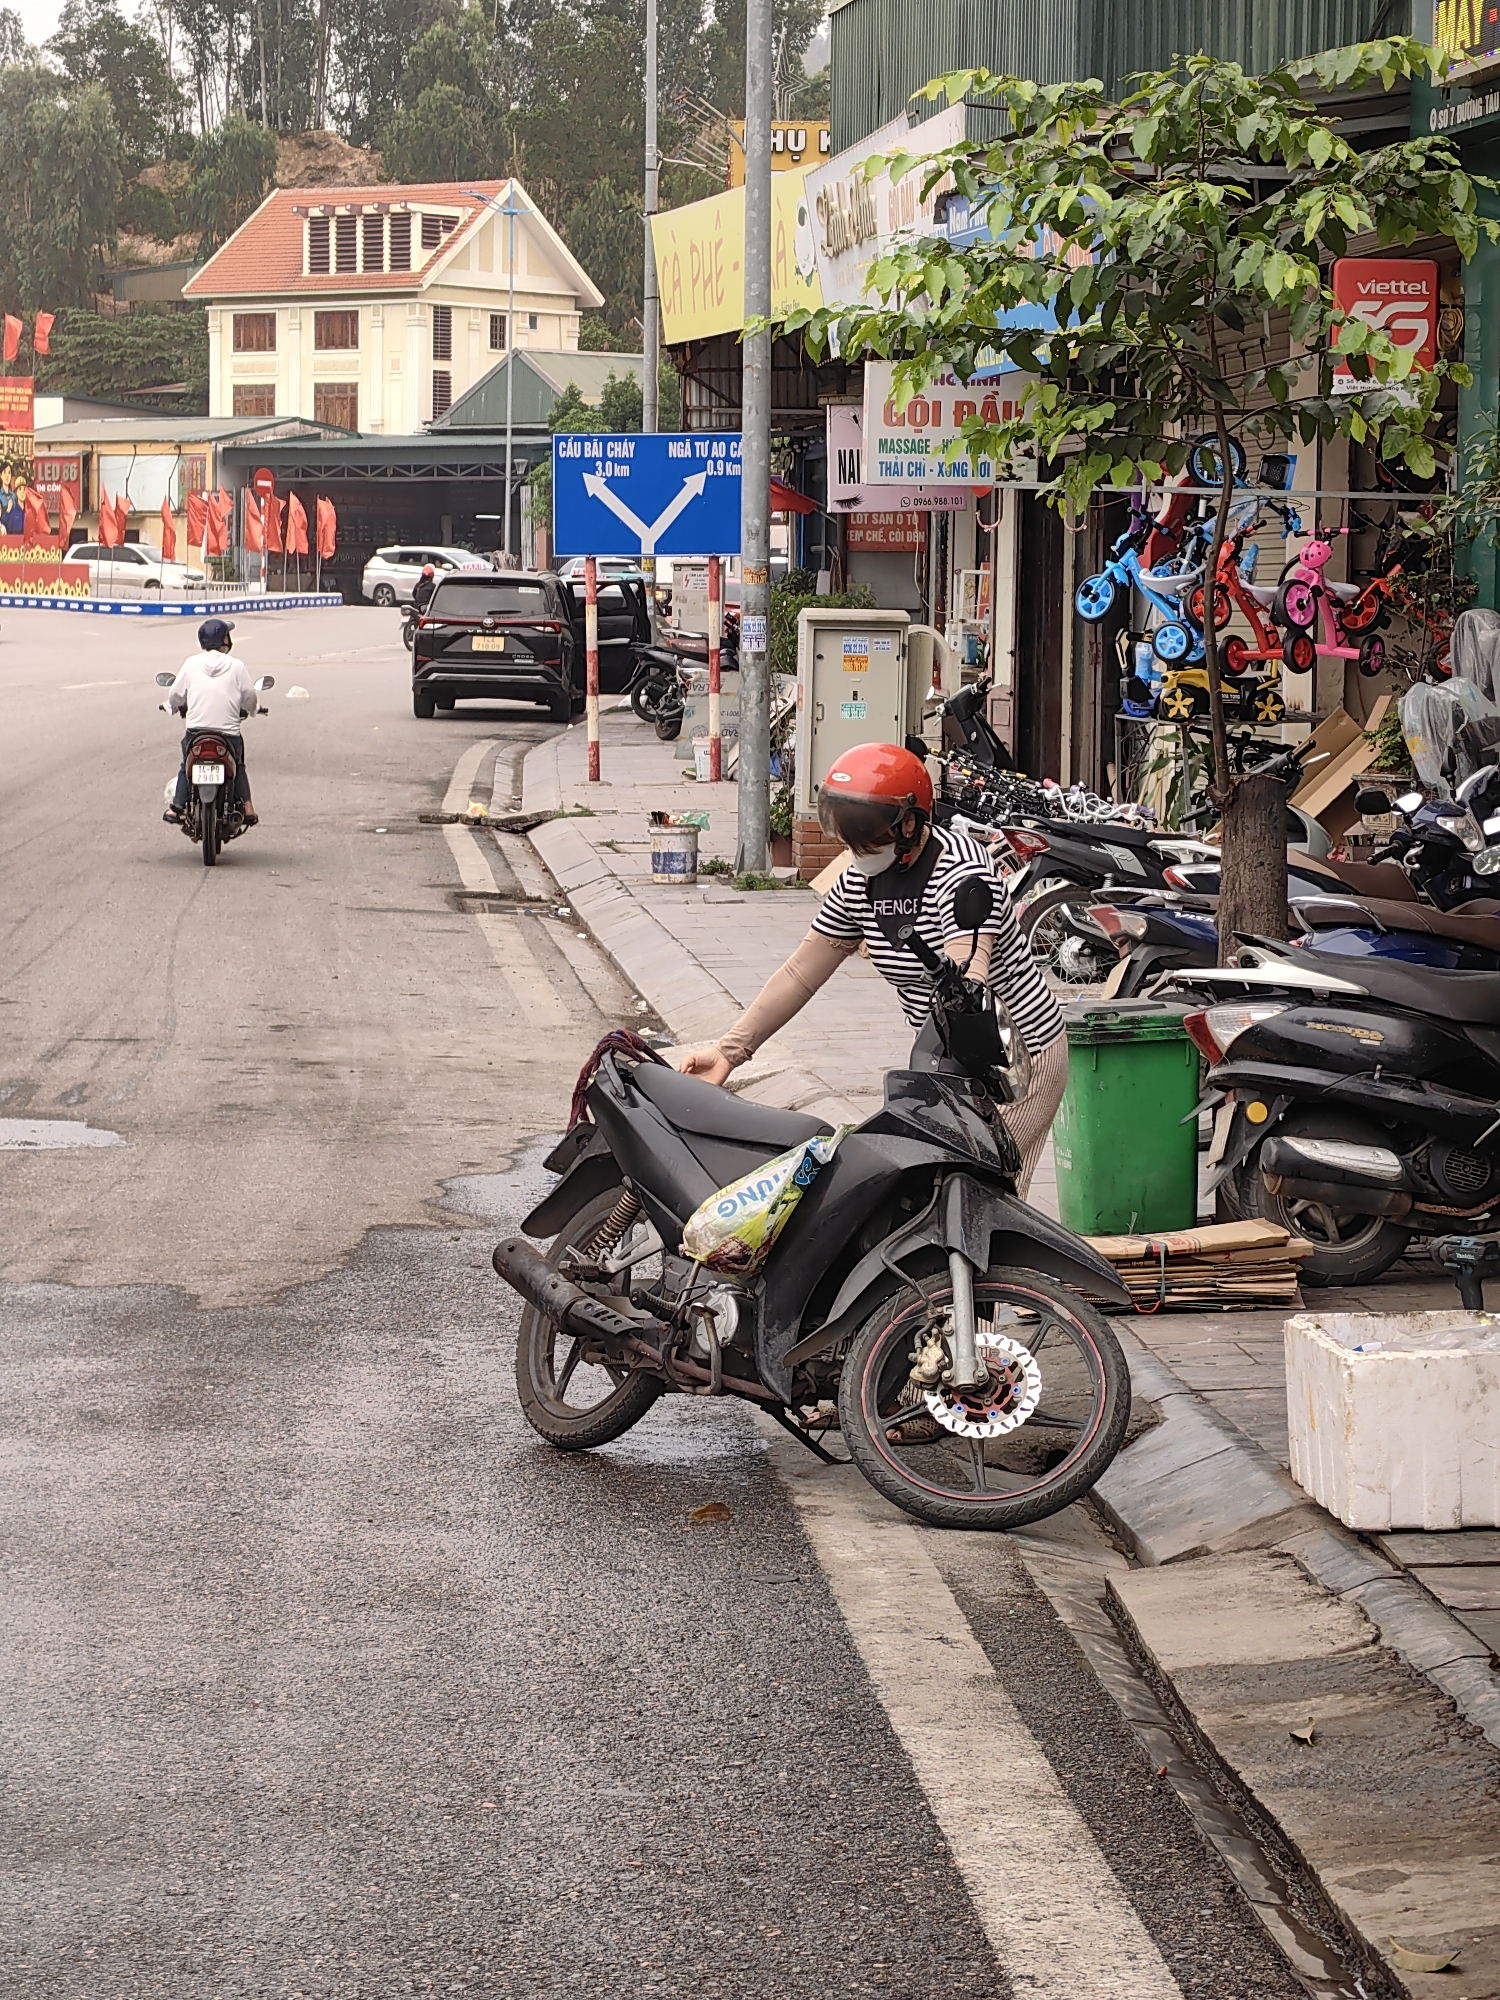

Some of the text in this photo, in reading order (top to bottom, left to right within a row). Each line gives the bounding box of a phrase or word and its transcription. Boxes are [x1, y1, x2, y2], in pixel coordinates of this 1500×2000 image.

[1450, 107, 1456, 126] 7
[743, 128, 807, 161] HỤ
[661, 230, 683, 315] CÀ
[690, 209, 724, 313] PHÊ
[1357, 279, 1430, 295] viettel
[883, 391, 1025, 434] GỘI ĐẦU
[584, 438, 603, 458] BÃI
[606, 438, 636, 458] CHÁY
[668, 438, 692, 458] NGÃ
[694, 439, 709, 458] TƯ
[711, 441, 727, 458] AO
[878, 438, 931, 455] MASSAGE
[37, 462, 78, 481] LED 86
[595, 460, 630, 477] 3.0 km
[706, 459, 741, 476] 0.9 Km
[878, 456, 904, 477] THẢI
[907, 458, 926, 477] CHÌ
[46, 482, 61, 492] CÔN
[913, 496, 964, 507] 0966.988.101
[462, 563, 482, 571] TAXI
[197, 774, 220, 783] 2901
